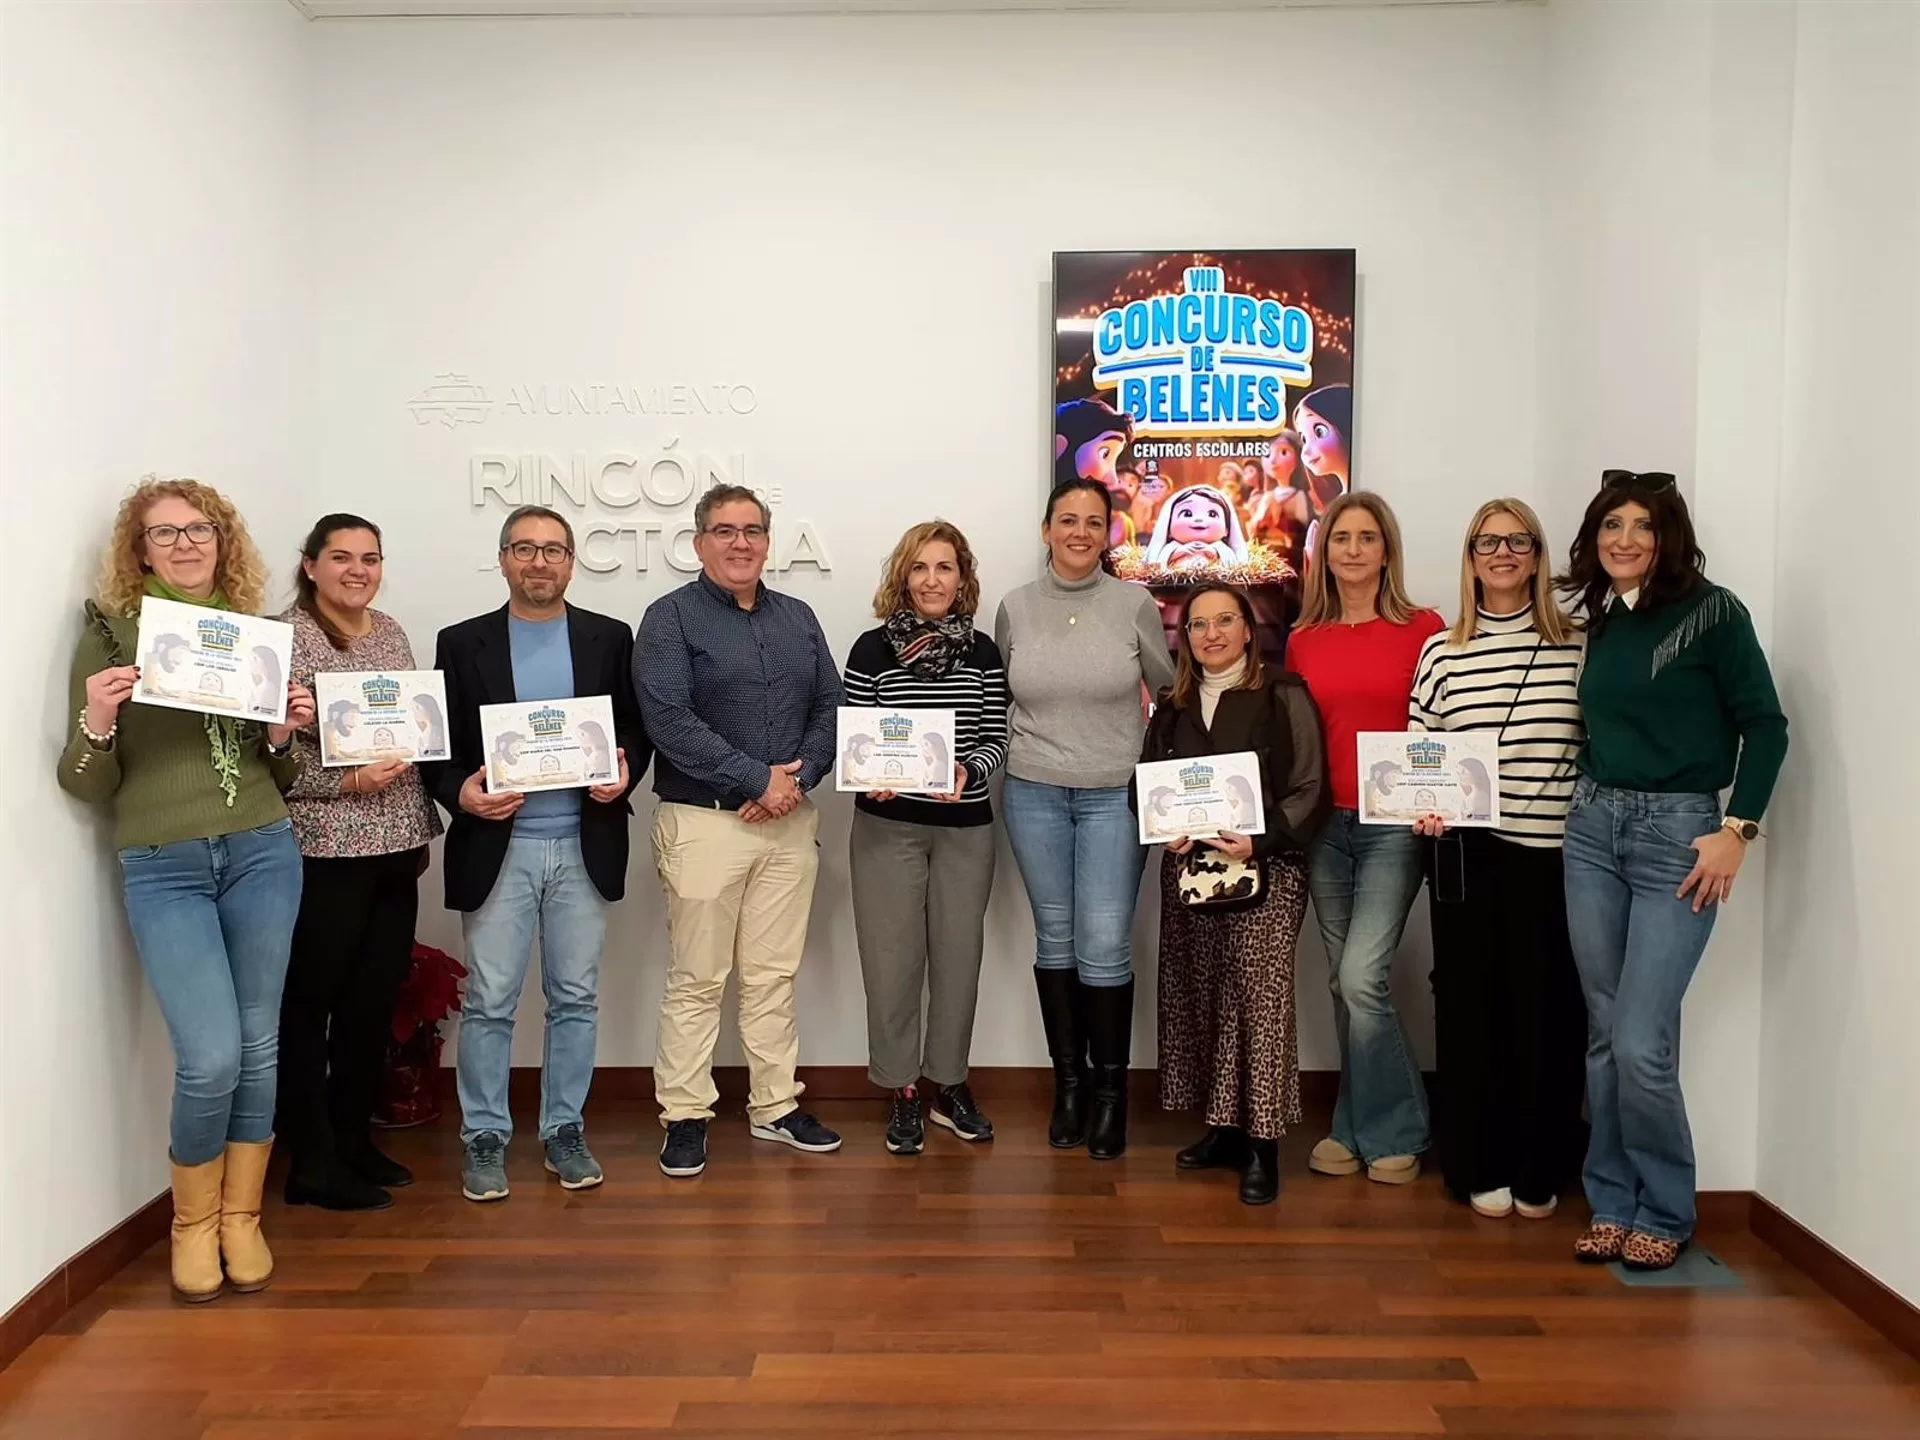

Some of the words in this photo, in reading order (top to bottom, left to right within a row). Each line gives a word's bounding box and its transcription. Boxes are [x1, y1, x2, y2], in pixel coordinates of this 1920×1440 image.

[1190, 268, 1217, 292] VIII
[1099, 294, 1306, 355] CONCURSO
[1191, 346, 1214, 371] DE
[501, 384, 758, 415] AYUNTAMIENTO
[1123, 373, 1280, 423] BELENES
[1133, 441, 1192, 458] CENTROS
[1196, 440, 1270, 457] ESCOLARES
[470, 436, 744, 507] RINCÓN
[754, 485, 783, 505] DE
